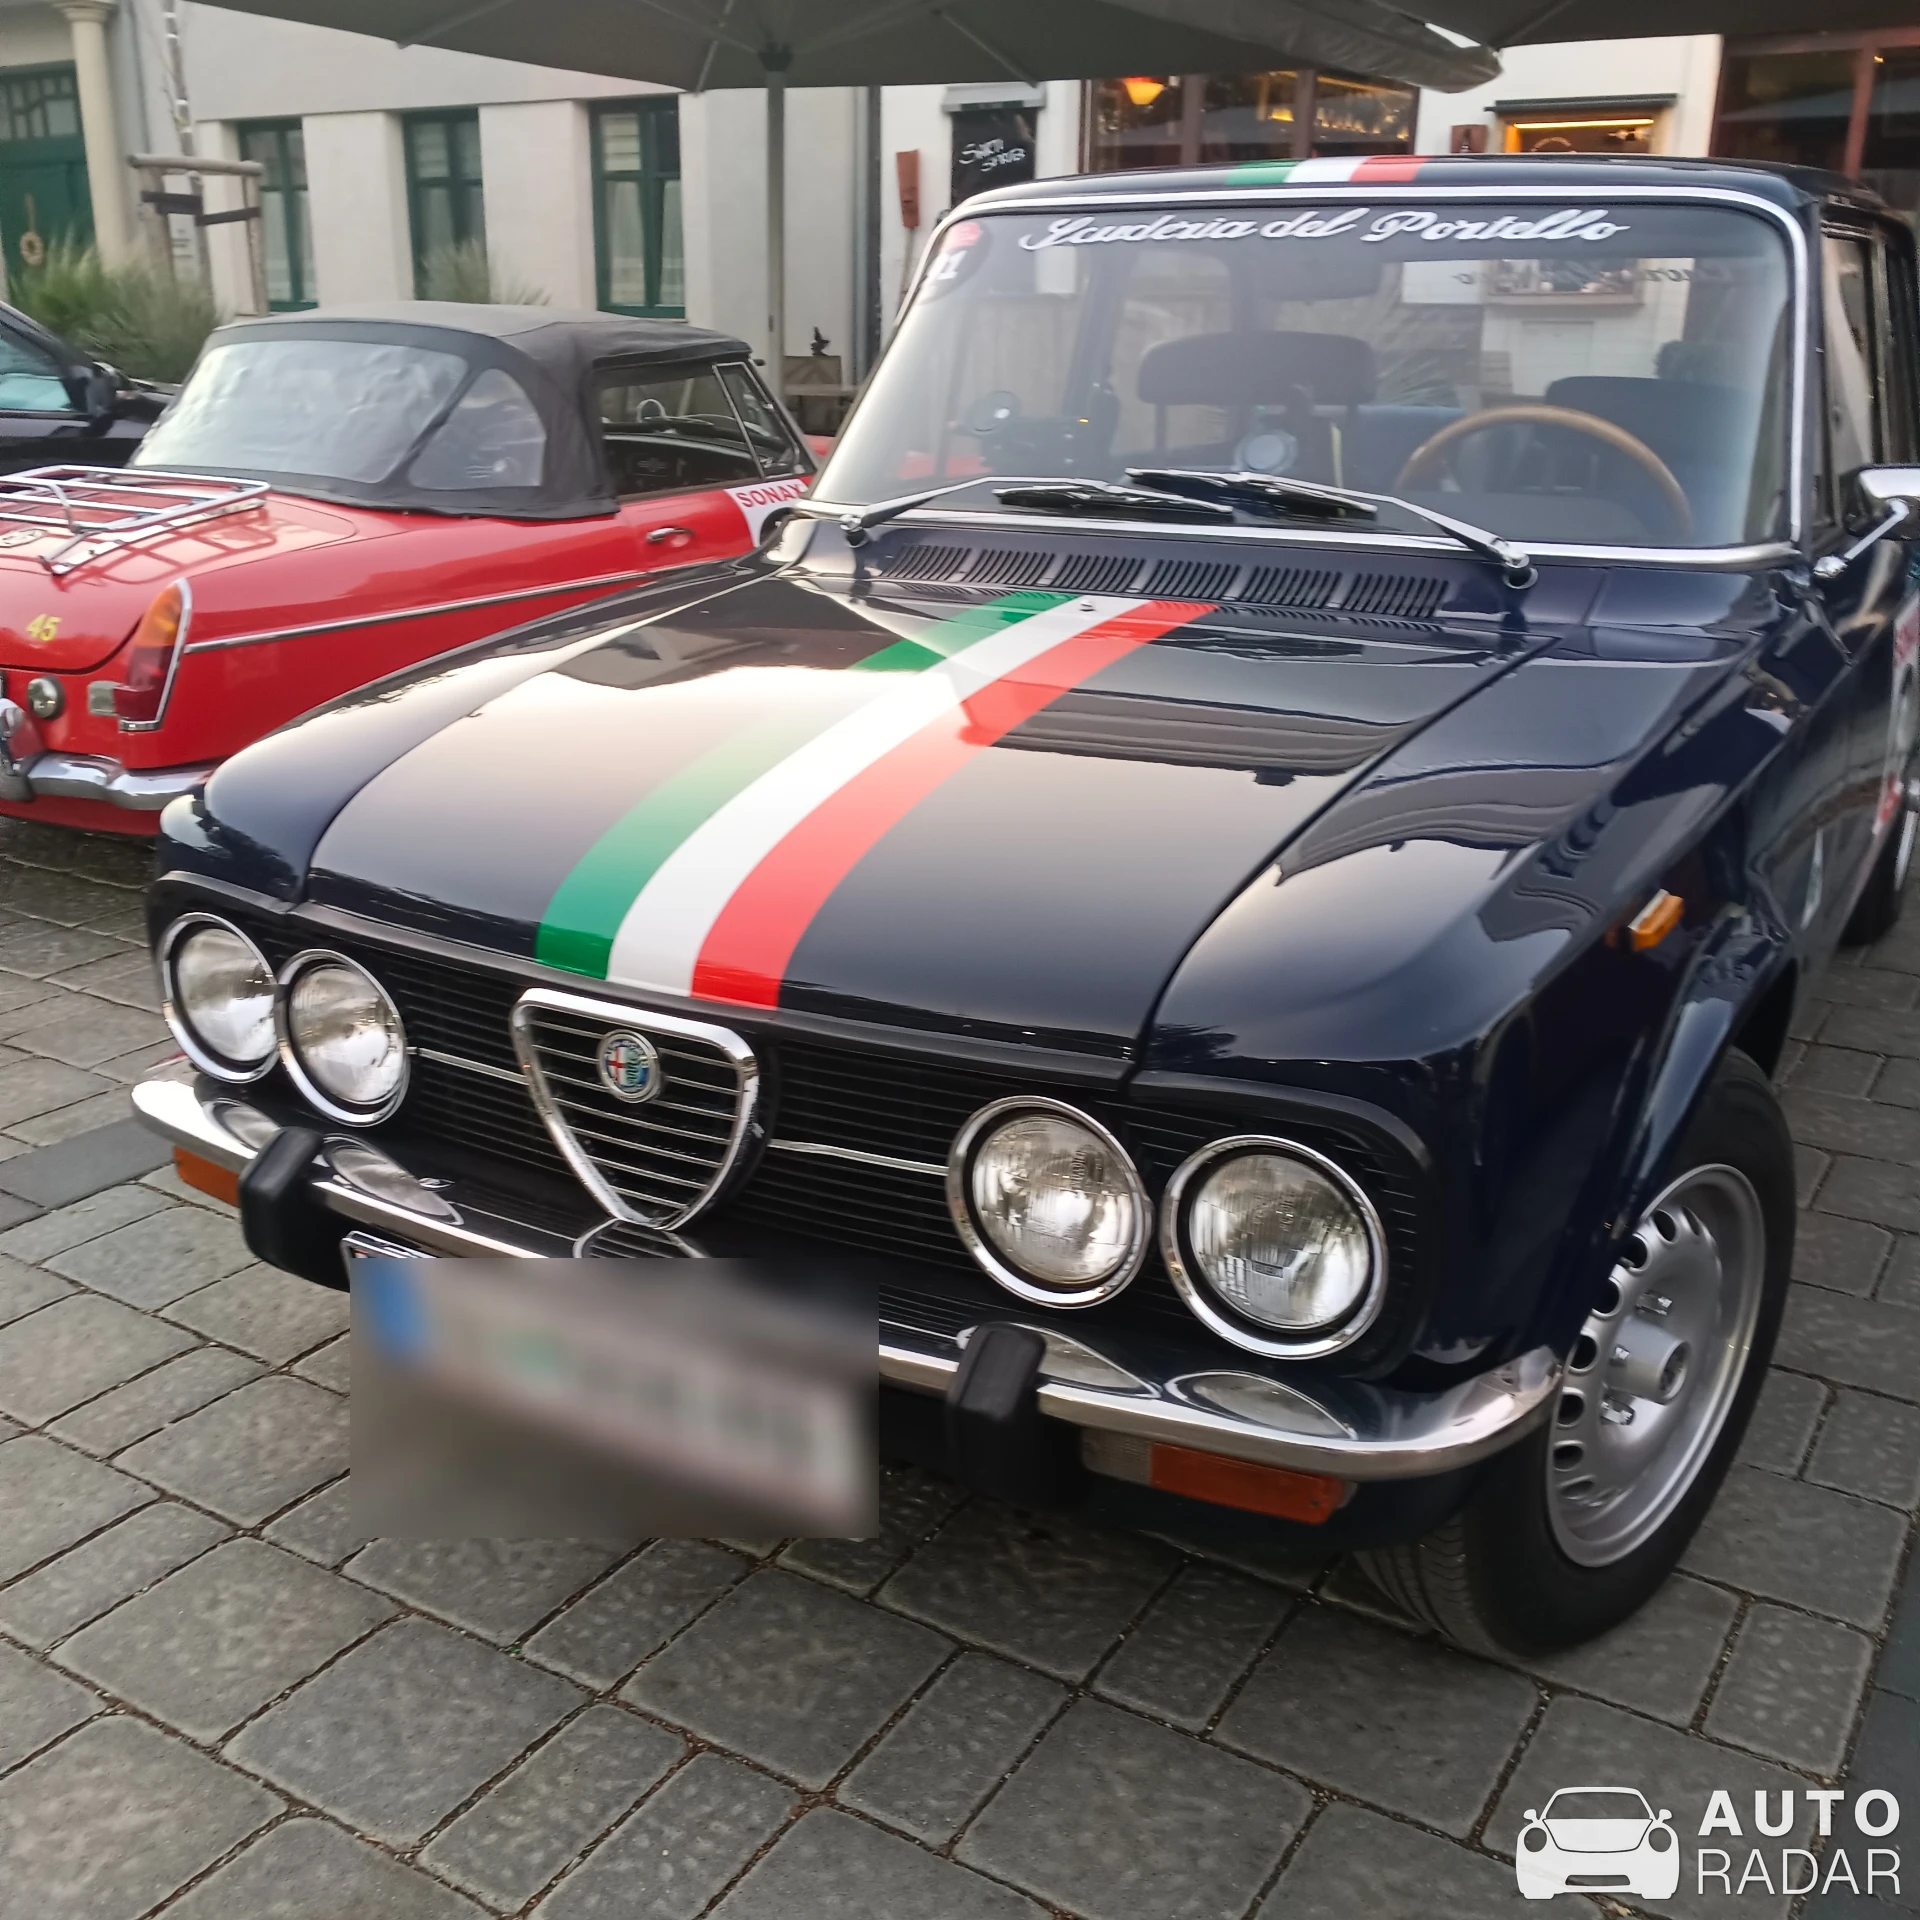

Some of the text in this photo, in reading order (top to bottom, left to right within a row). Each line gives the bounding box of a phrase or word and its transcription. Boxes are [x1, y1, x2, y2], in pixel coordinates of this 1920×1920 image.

[1259, 207, 1370, 239] del
[1360, 208, 1631, 242] Portello
[736, 483, 804, 508] SONAX
[26, 613, 63, 642] 45
